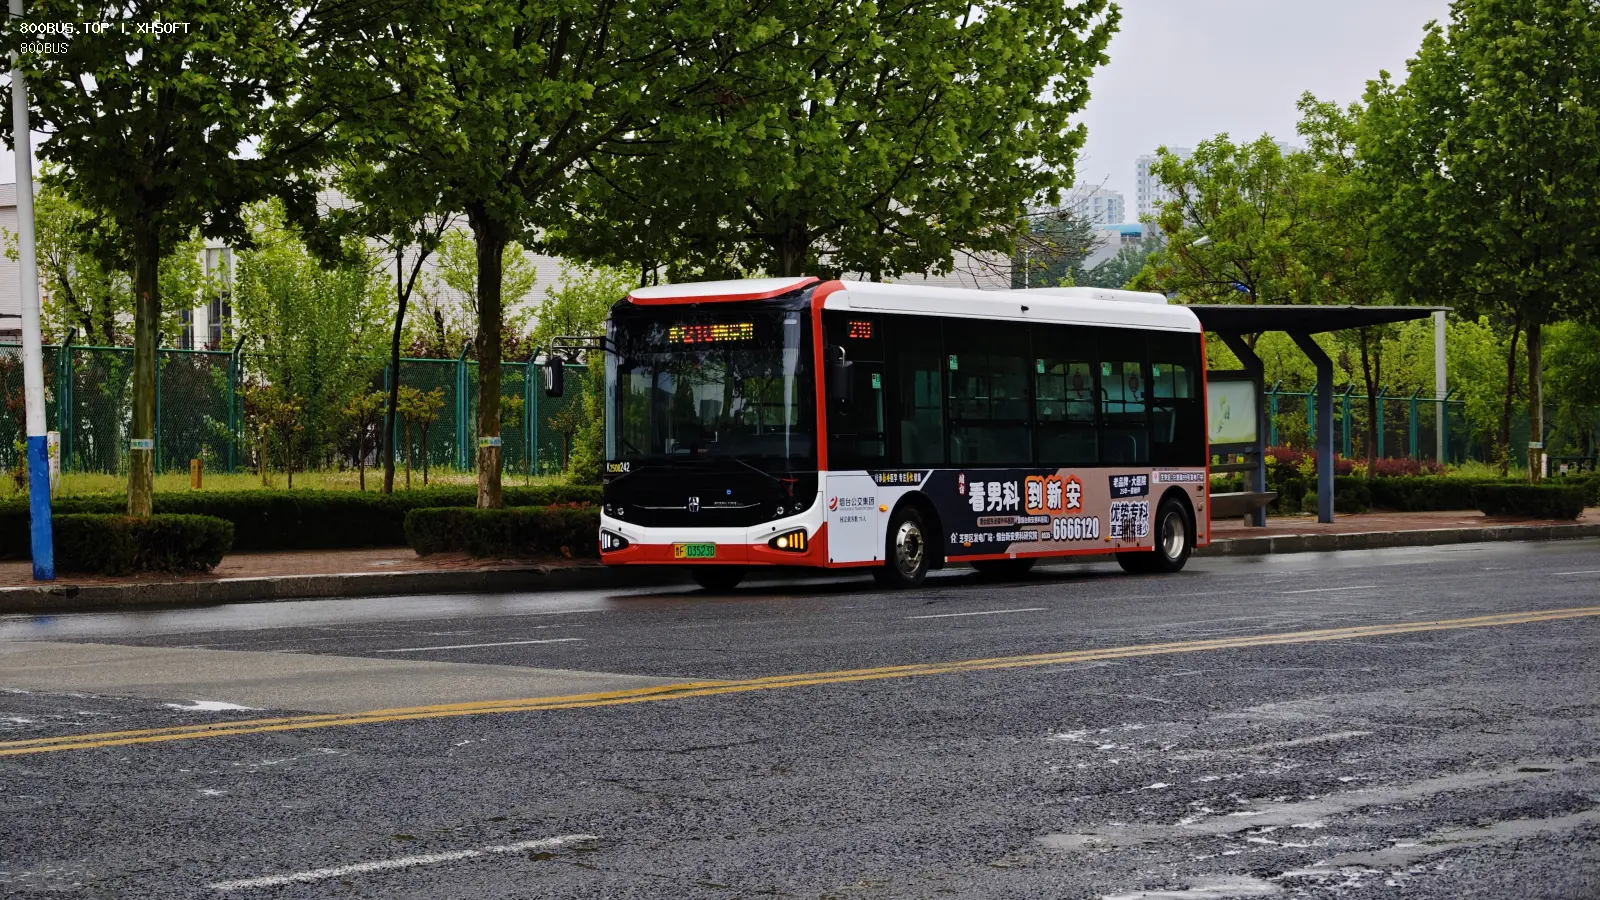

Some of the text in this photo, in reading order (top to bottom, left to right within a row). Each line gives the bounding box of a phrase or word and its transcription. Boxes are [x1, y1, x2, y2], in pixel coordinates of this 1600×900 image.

[839, 496, 875, 507] 烟台公交集团
[968, 479, 1081, 512] 看男科 到新安
[1110, 502, 1149, 522] 优势专科
